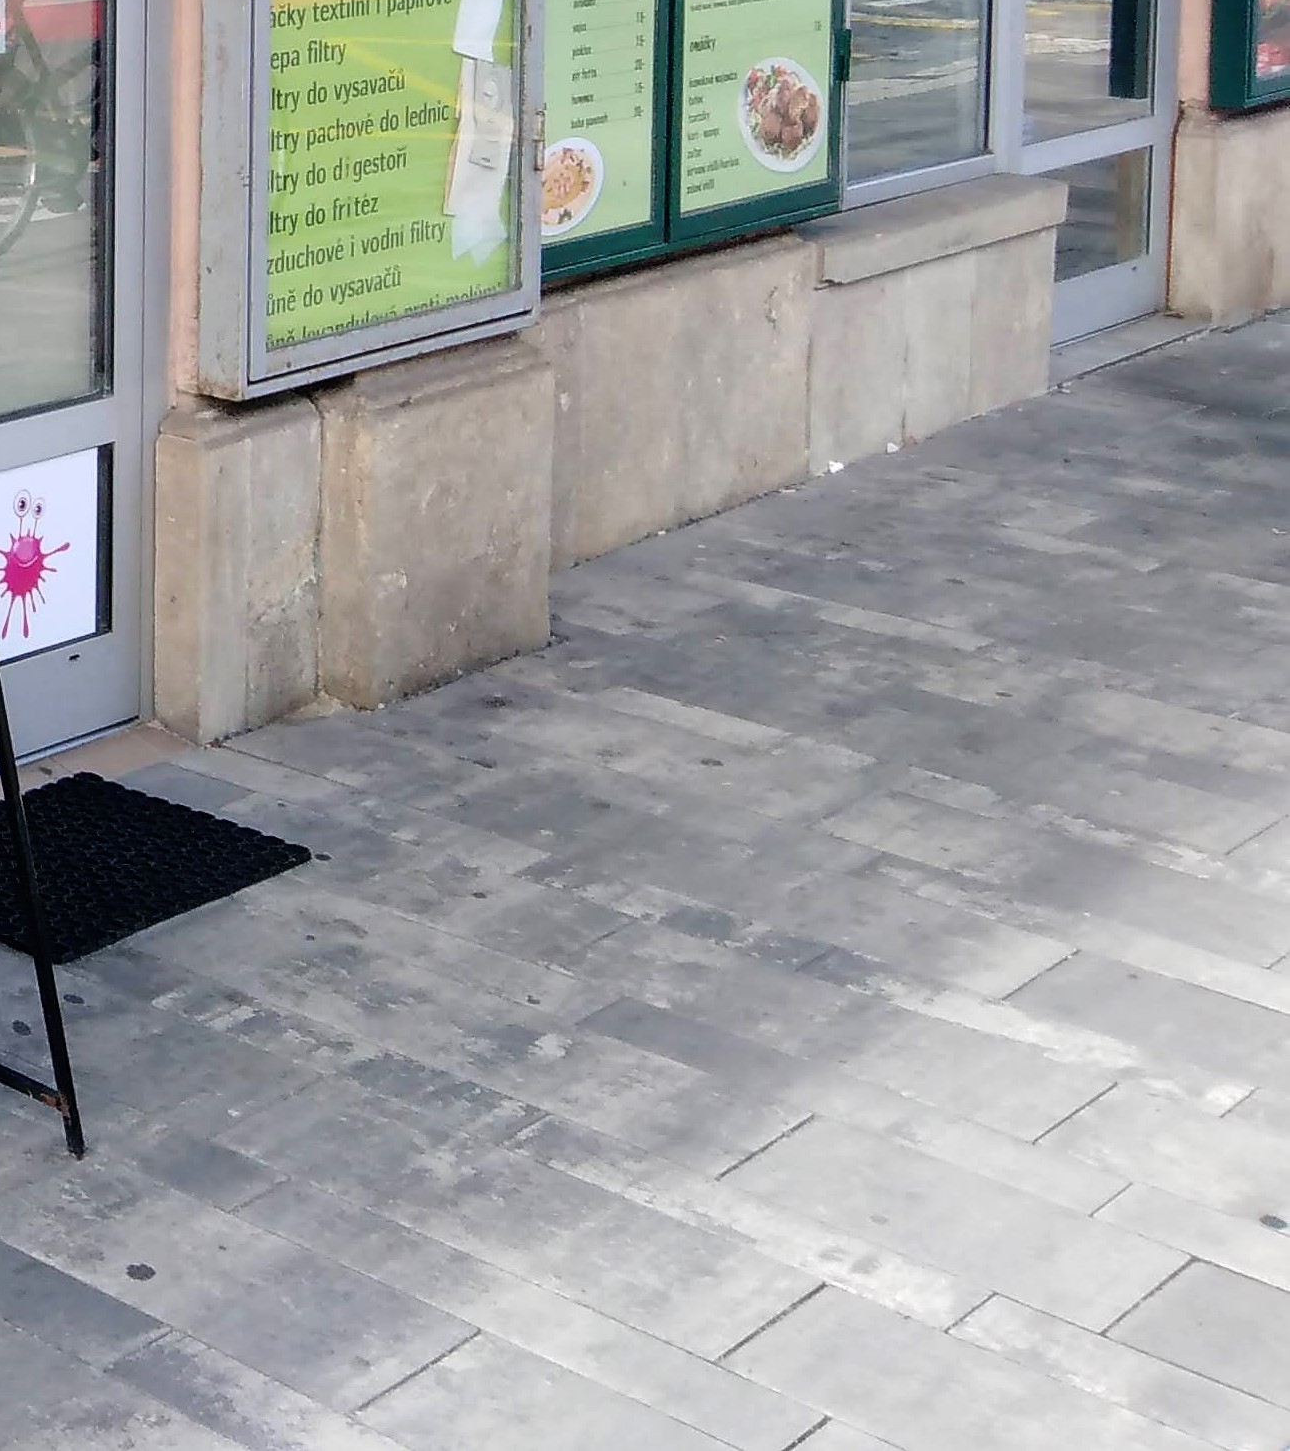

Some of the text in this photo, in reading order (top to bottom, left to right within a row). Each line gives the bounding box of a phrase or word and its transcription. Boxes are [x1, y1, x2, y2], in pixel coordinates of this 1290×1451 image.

[270, 4, 307, 30] áčky
[270, 39, 348, 73] epa filtry
[271, 68, 407, 113] ltry do vysavačů
[270, 99, 450, 154] ltry pachové do lednic
[268, 170, 300, 197] ltry
[305, 162, 327, 188] do
[268, 192, 380, 237] ltry do fritéz
[266, 219, 448, 276] zduchové i vodní filtry
[266, 263, 403, 317] ůně do vysavačů
